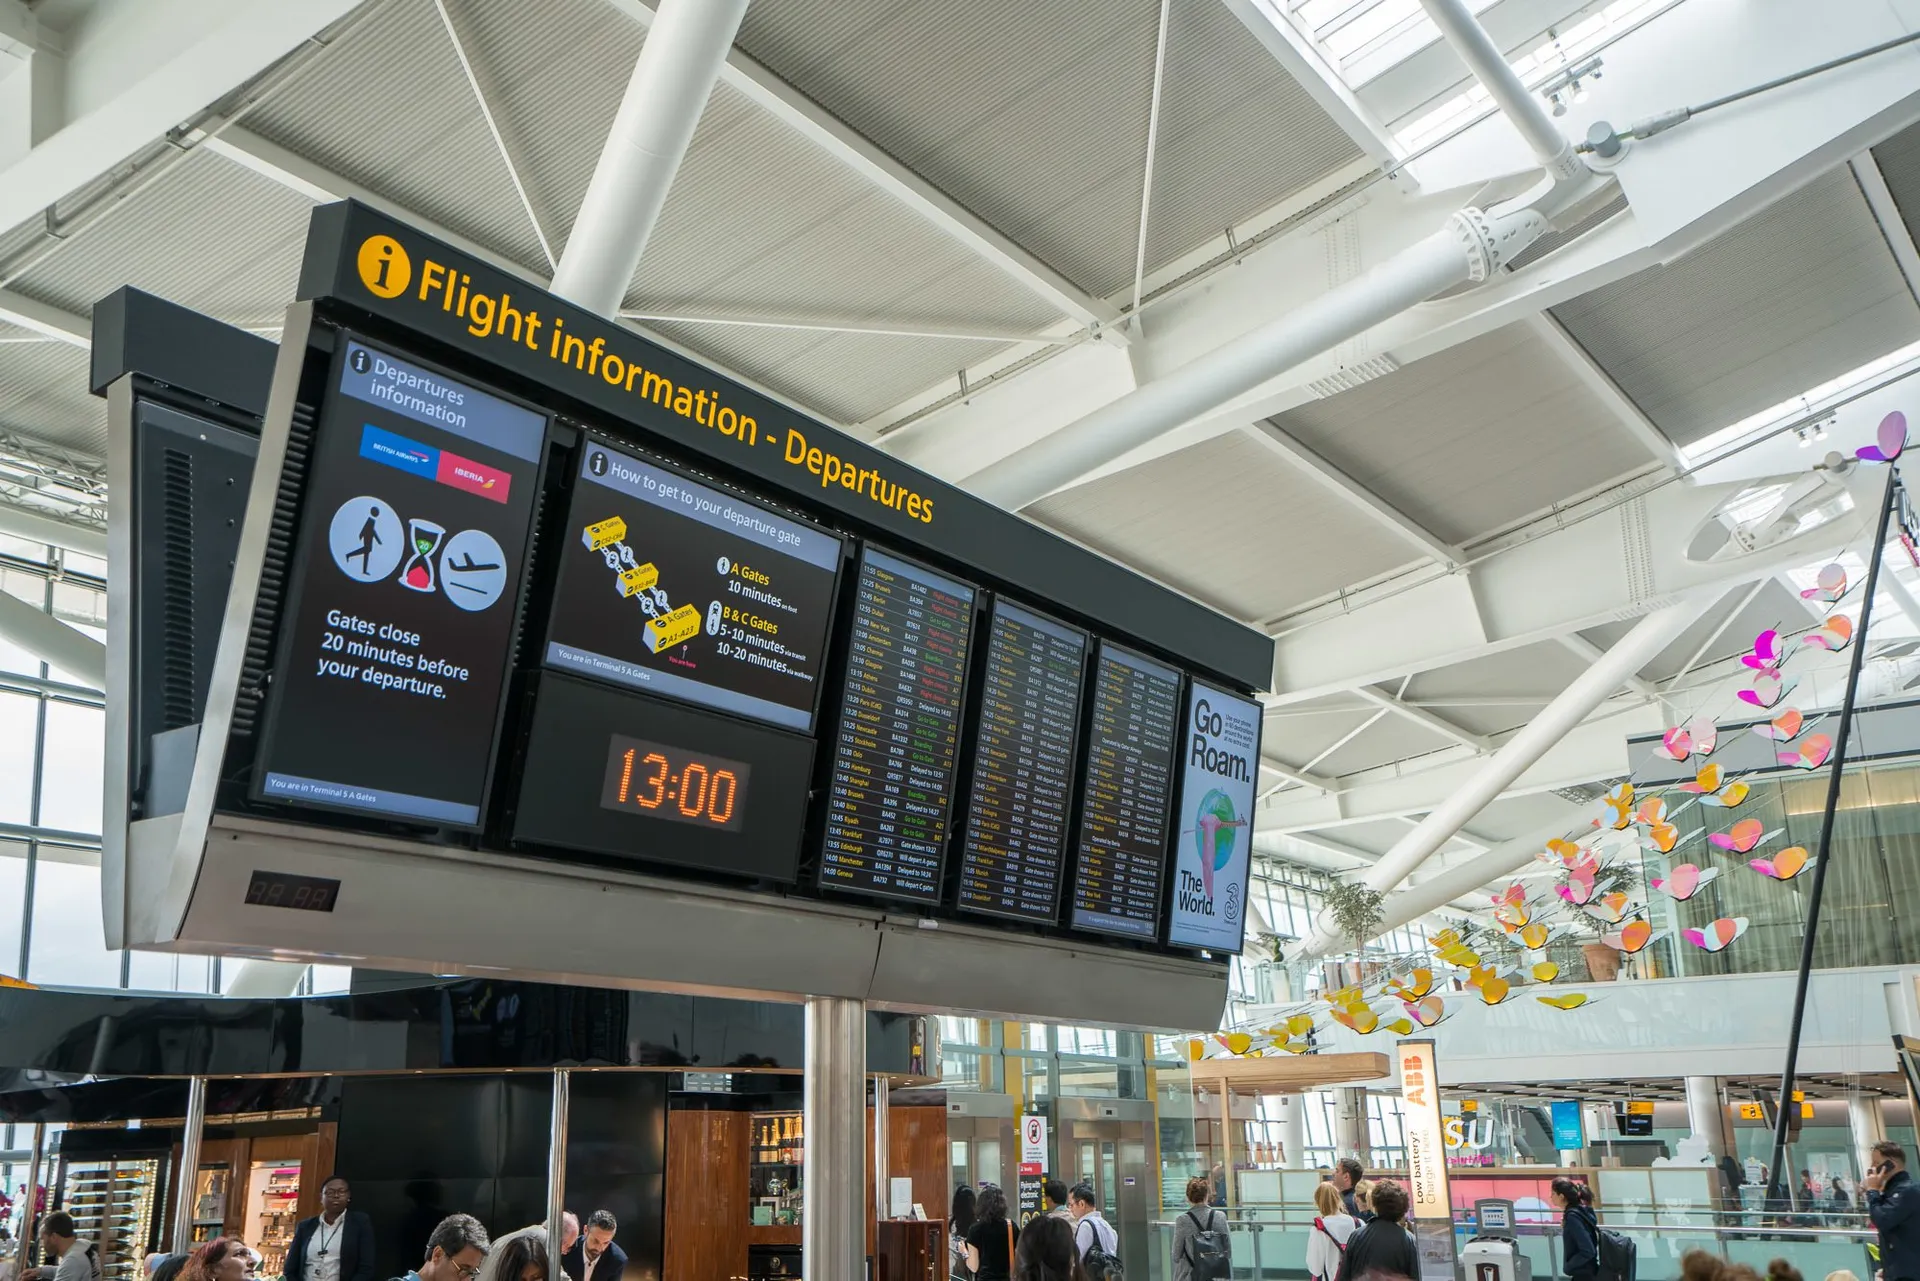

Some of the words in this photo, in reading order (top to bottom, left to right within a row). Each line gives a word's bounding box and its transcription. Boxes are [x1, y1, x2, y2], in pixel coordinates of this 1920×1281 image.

[374, 359, 463, 405] Departures
[420, 261, 540, 348] Flight
[552, 320, 756, 443] information
[785, 430, 932, 521] Departures
[371, 379, 465, 426] information
[373, 443, 395, 454] BRITISH
[395, 451, 417, 462] AIRWAYS
[454, 467, 483, 482] IBERIA
[611, 462, 640, 483] How
[643, 475, 656, 490] to
[658, 483, 678, 499] get
[681, 490, 692, 504] to
[694, 497, 721, 515] your
[723, 507, 776, 536] departure
[777, 530, 800, 546] gate
[730, 562, 738, 575] A
[741, 566, 769, 585] Gates
[728, 579, 740, 593] 10
[742, 586, 781, 607] minutes
[787, 605, 797, 613] foot
[327, 609, 375, 635] Gates
[379, 624, 419, 646] close
[667, 614, 674, 623] A
[673, 607, 693, 620] Gates
[723, 606, 730, 618] B
[731, 609, 739, 621] &
[741, 612, 749, 624] C
[750, 615, 777, 633] Gates
[667, 625, 694, 644] A1-A23
[719, 623, 744, 641] 5-10
[745, 634, 784, 654] minutes
[791, 652, 806, 661] transit
[321, 632, 343, 651] 20
[347, 641, 413, 667] minutes
[417, 654, 468, 680] before
[558, 649, 572, 659] You
[572, 654, 584, 662] are
[584, 655, 591, 664] in
[593, 658, 620, 672] Terminal
[625, 667, 631, 675] A
[632, 669, 650, 680] Gates
[717, 642, 746, 660] 10-20
[747, 653, 786, 672] minutes
[317, 659, 358, 678] your
[362, 667, 445, 698] departure.
[1194, 699, 1222, 737] Go
[1191, 734, 1249, 782] Roam.
[271, 779, 286, 788] You
[300, 783, 308, 791] in
[310, 785, 342, 796] Terminal
[355, 792, 375, 802] Gates
[617, 748, 737, 823] 13:00
[1181, 869, 1202, 892] The
[1179, 891, 1214, 915] World.
[1404, 1056, 1427, 1106] ABB
[1410, 1131, 1421, 1178] battery?
[1446, 1153, 1494, 1165] eautiful
[1425, 1166, 1436, 1204] Charge
